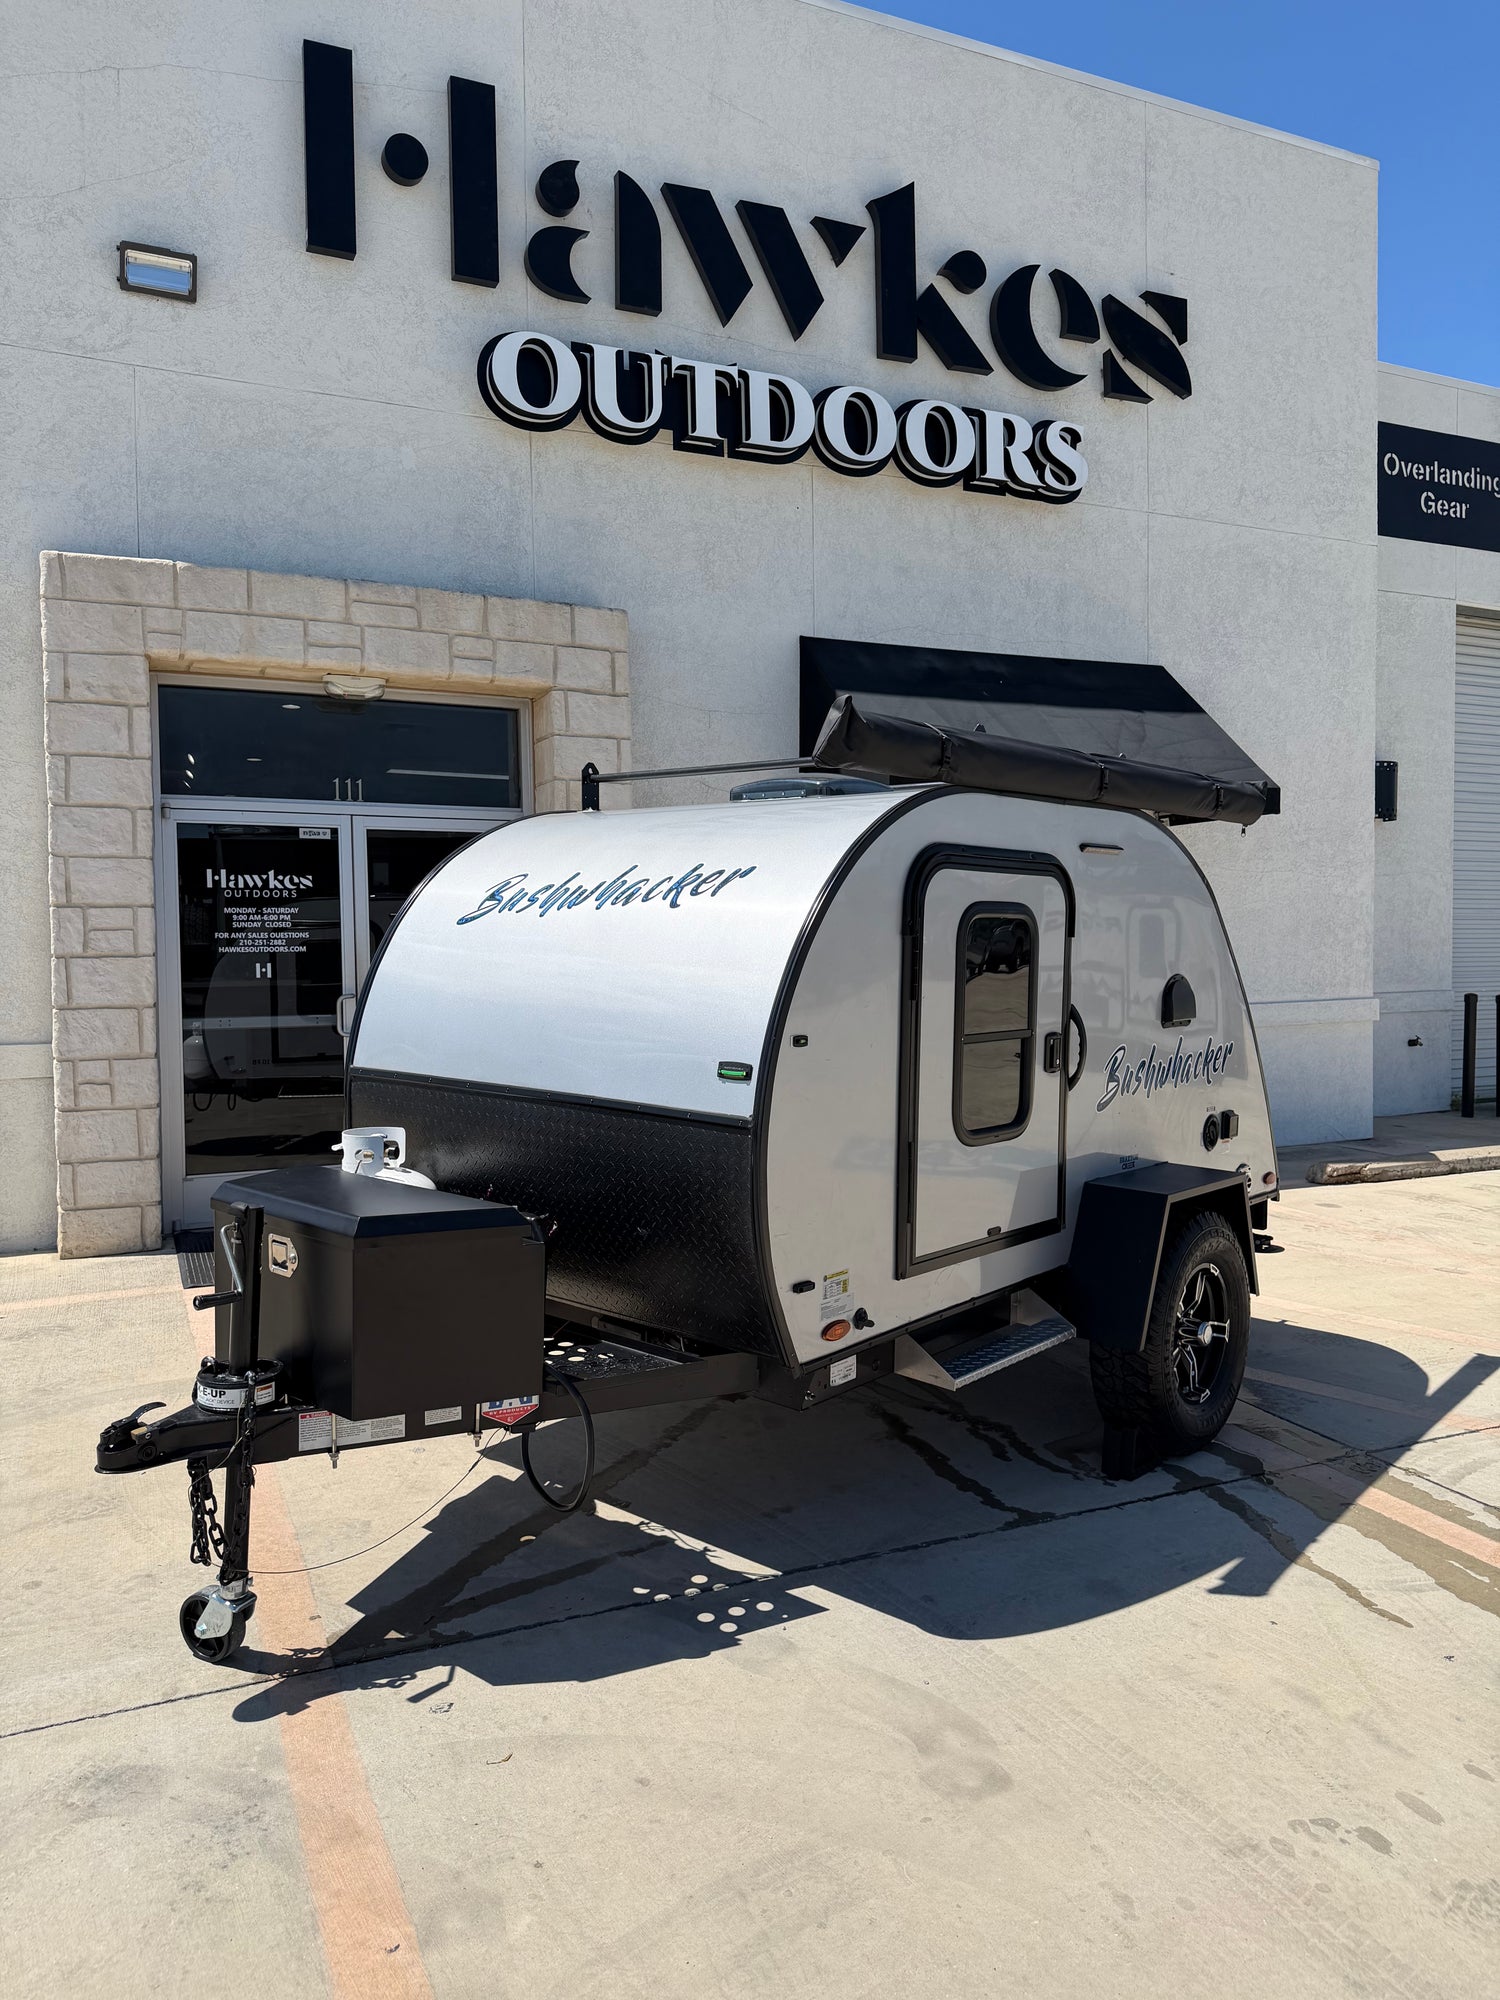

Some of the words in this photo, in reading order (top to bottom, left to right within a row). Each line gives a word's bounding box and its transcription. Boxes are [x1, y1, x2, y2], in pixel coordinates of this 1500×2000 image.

[302, 38, 1192, 404] Hawkes
[479, 331, 1089, 503] OUTDOORS
[1383, 452, 1500, 499] Overlanding
[1420, 491, 1470, 519] Gear
[332, 777, 364, 802] 111
[206, 868, 313, 889] Hawkes
[224, 889, 297, 898] OUTDOORS
[456, 862, 758, 926] Bushwhacker
[1096, 1035, 1235, 1113] Bushwhacker
